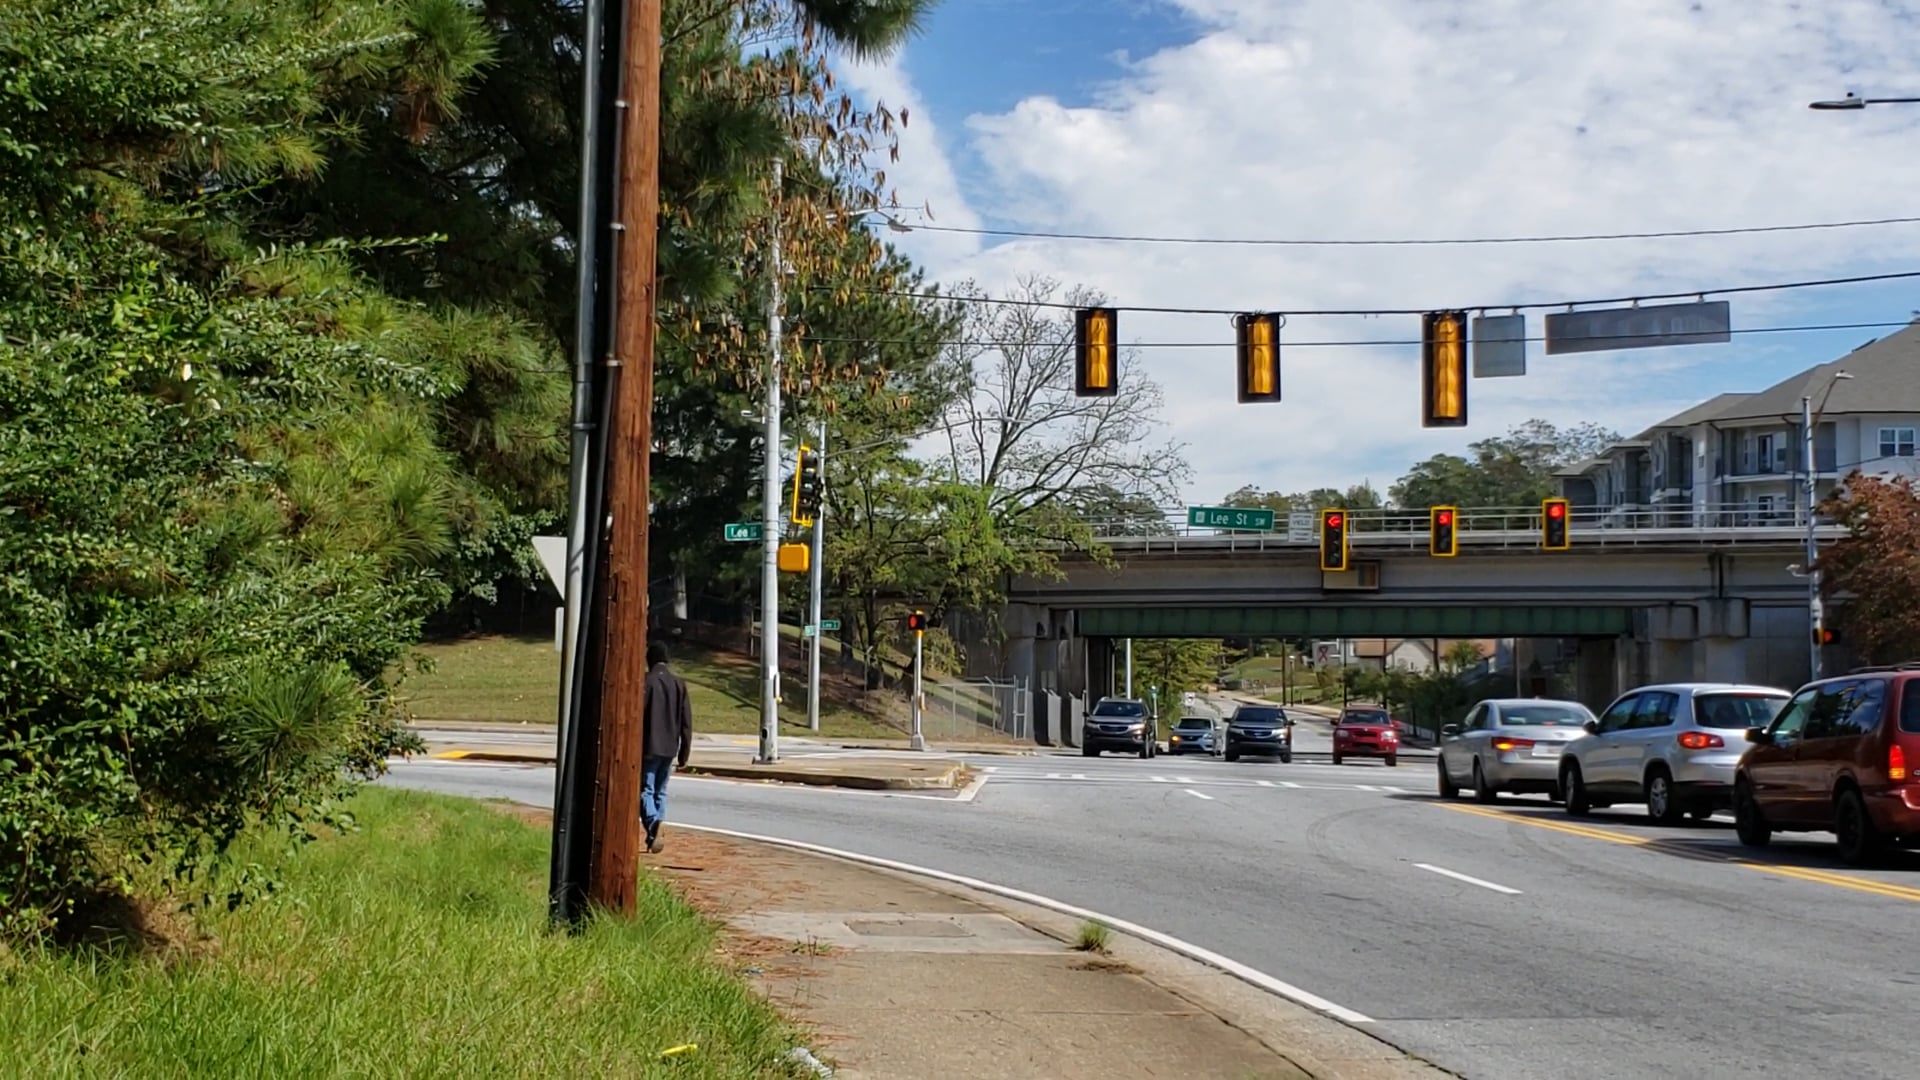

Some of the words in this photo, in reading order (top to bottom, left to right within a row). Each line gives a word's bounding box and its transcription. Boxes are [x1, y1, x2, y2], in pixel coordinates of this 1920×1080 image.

[1210, 511, 1229, 524] Lee
[1236, 513, 1247, 525] St
[731, 527, 748, 538] Lee
